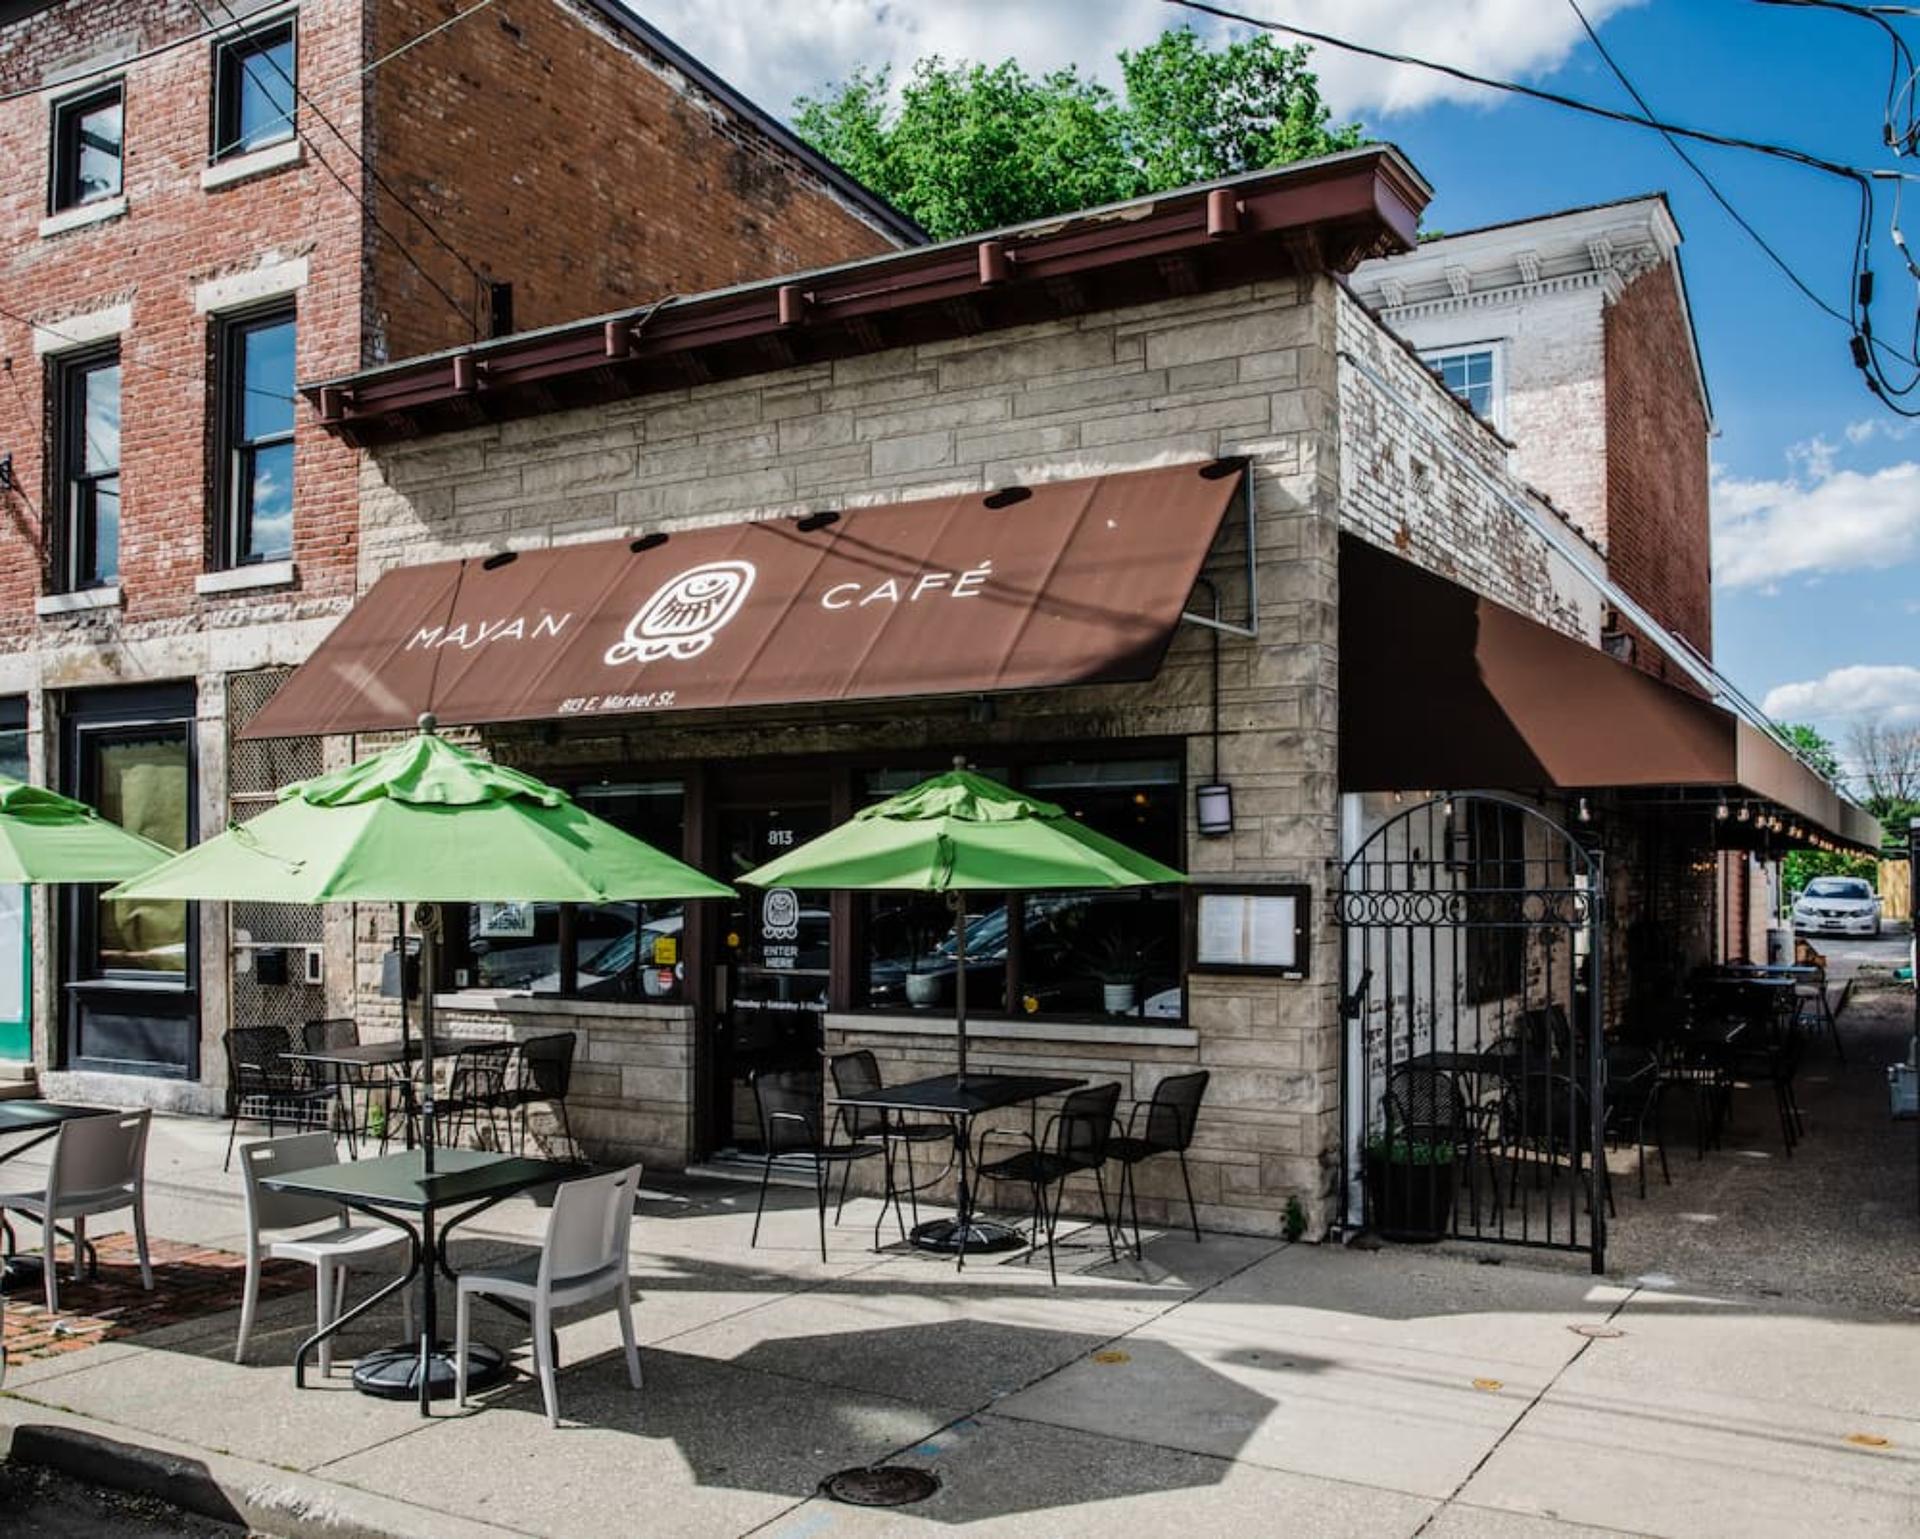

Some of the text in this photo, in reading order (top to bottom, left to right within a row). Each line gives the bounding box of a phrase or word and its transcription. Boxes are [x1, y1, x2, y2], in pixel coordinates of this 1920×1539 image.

[405, 559, 993, 651] MAYAN CAFÉ
[600, 692, 656, 709] Market
[768, 830, 793, 846] 813
[763, 945, 799, 957] ENTER
[765, 956, 795, 968] HERE
